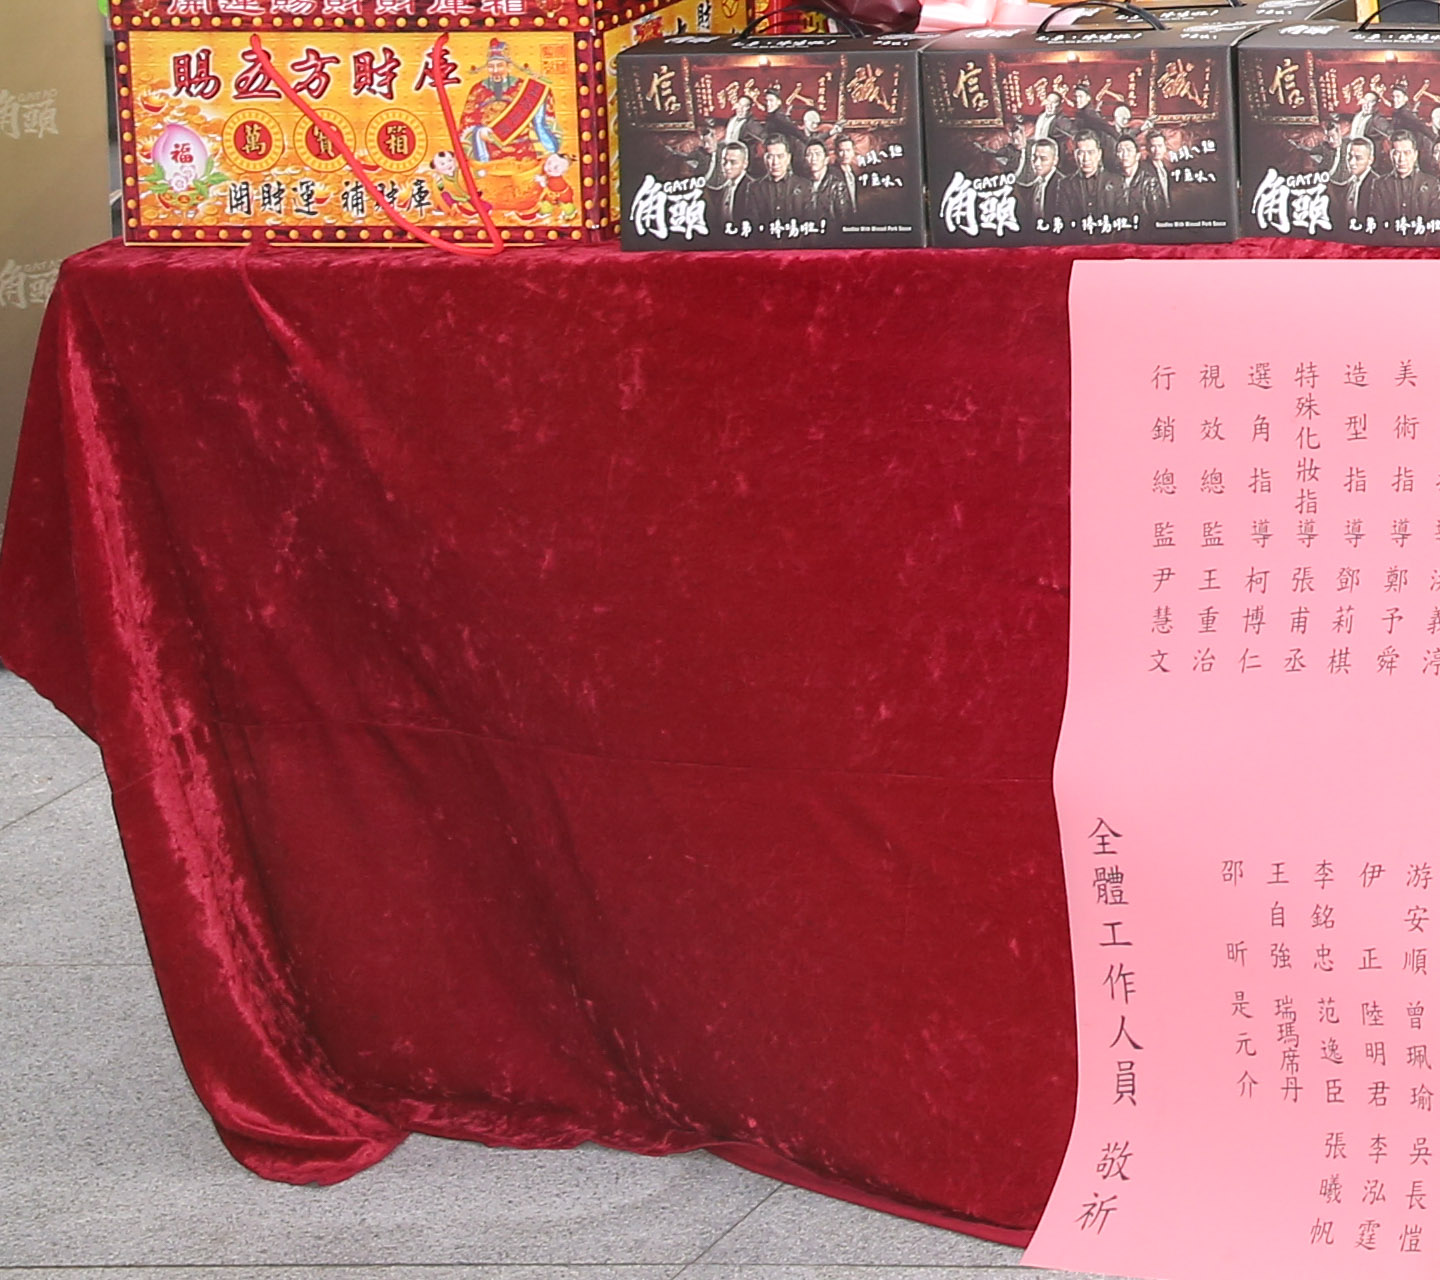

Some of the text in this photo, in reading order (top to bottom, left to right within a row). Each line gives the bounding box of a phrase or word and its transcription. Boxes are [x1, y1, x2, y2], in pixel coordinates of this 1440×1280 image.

[170, 142, 195, 164] 福
[630, 174, 709, 239] 角頭
[662, 177, 706, 194] GATAO
[1149, 365, 1176, 672] 行銷總監 尹慧文
[1193, 364, 1225, 672] 視效總監 王重治
[1240, 363, 1273, 673] 選角指導 柯博仁
[1285, 567, 1314, 672] 張甫丞
[1328, 362, 1369, 674] 造型指導 鄧莉棋
[1377, 360, 1419, 675] 美術指導 鄭予舜
[1075, 817, 1144, 1234] 全體工作人員 敬祈
[1232, 991, 1258, 1098] 是元介
[1267, 862, 1303, 1103] 王自強 瑞瑪席丹
[1312, 859, 1344, 1103] 李銘忠 范逸臣
[1362, 1000, 1390, 1106] 陸明君
[1403, 862, 1434, 1112] 游安順 曾珮瑜
